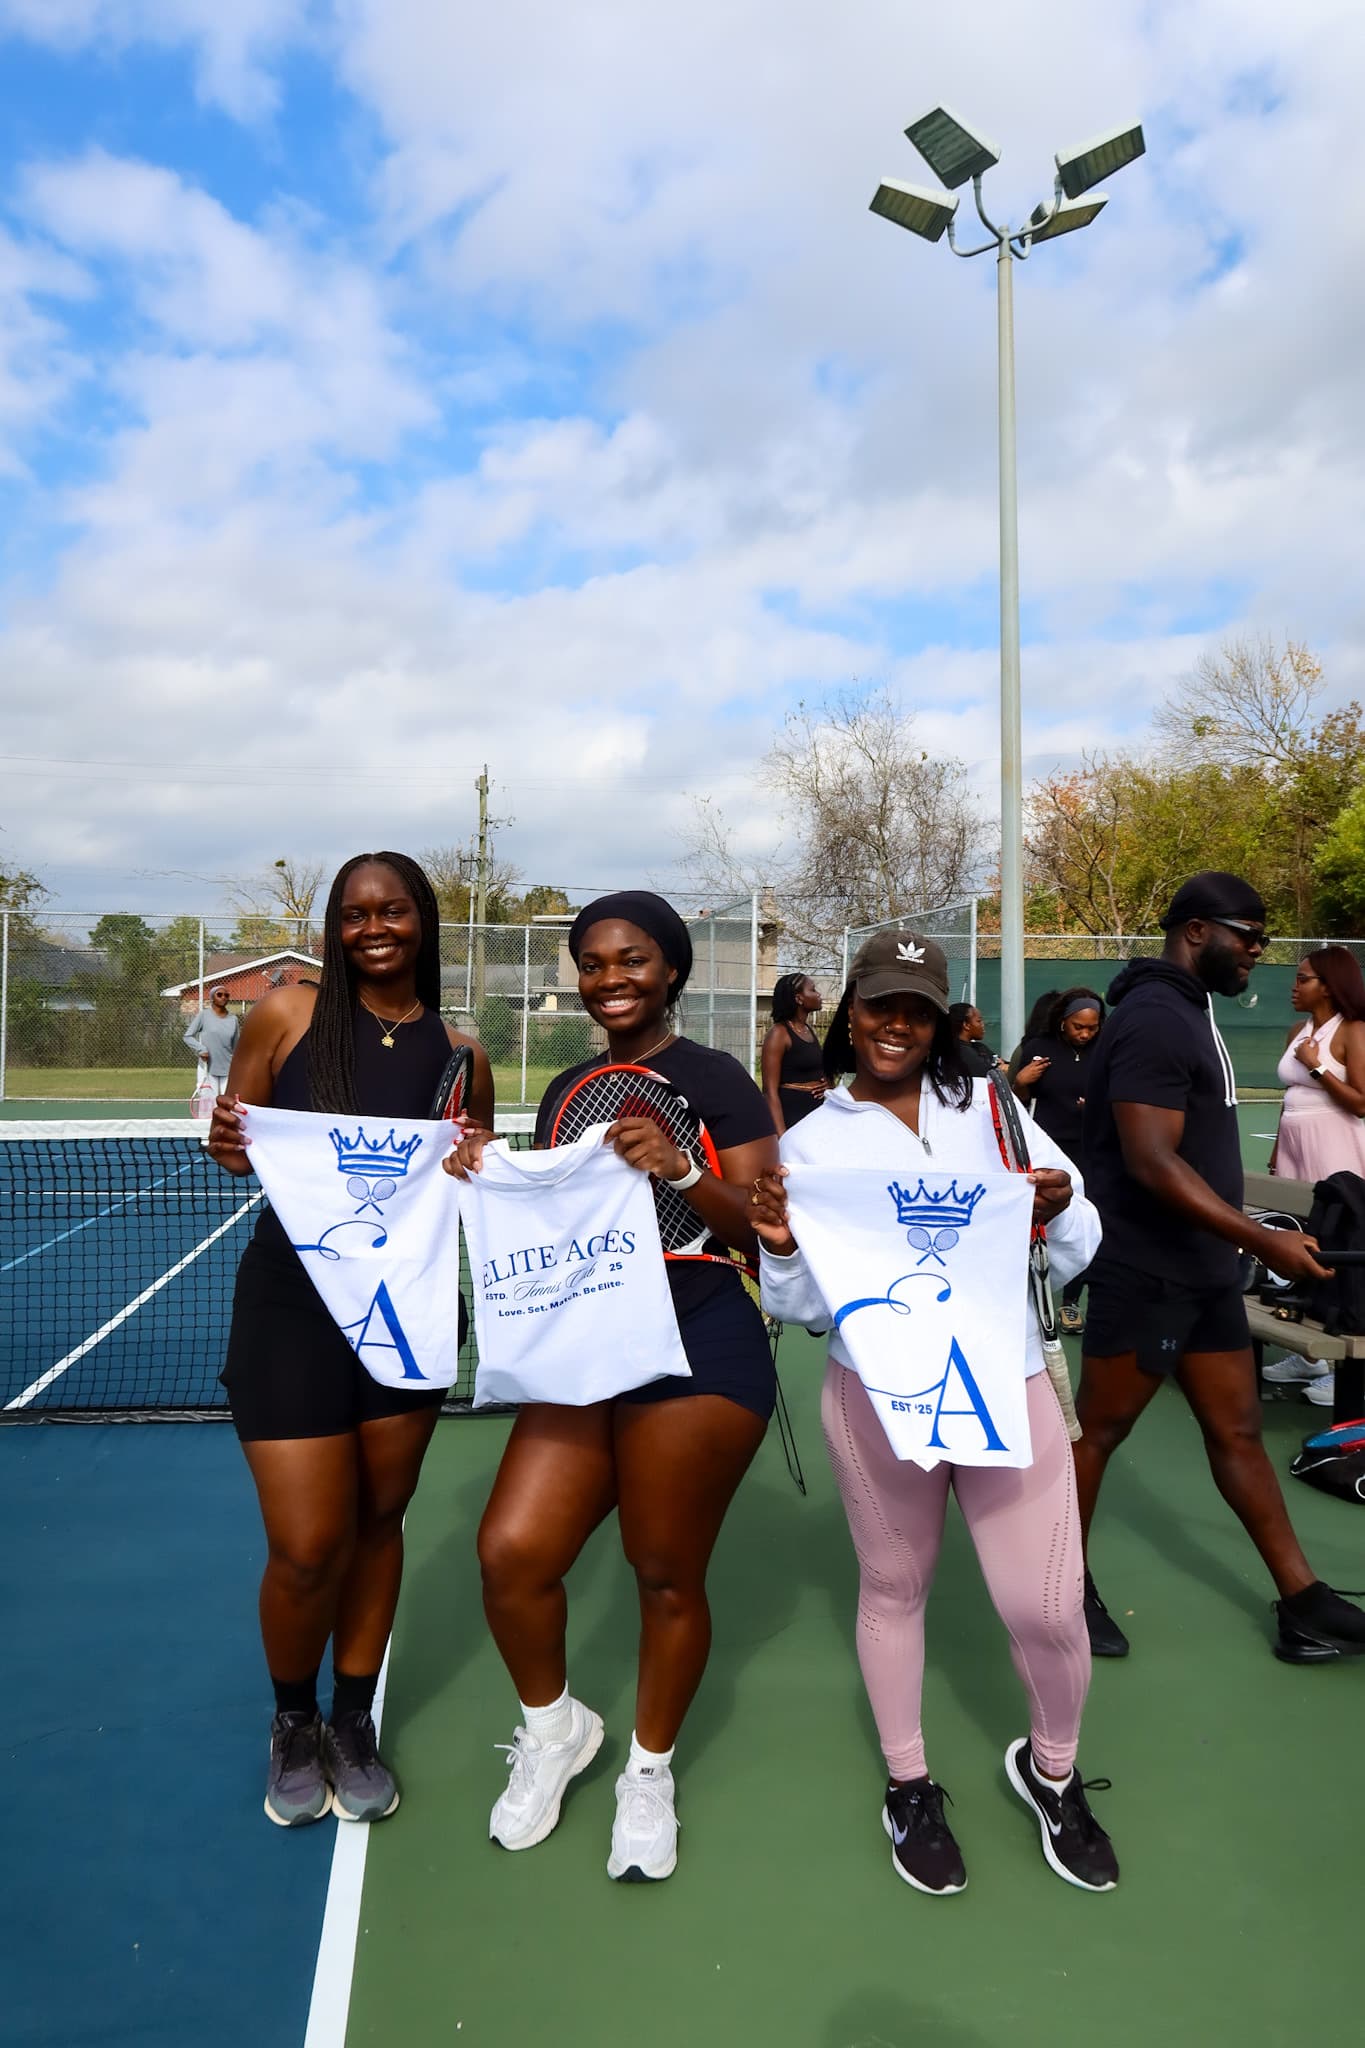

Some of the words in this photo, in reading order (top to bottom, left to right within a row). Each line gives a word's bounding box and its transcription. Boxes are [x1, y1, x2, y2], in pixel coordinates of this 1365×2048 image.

[482, 1245, 558, 1289] ELITE
[565, 1229, 636, 1262] ACES
[498, 1309, 525, 1317] Love.
[527, 1305, 548, 1314] Set.
[583, 1287, 596, 1295] Be
[597, 1280, 624, 1291] Elite.
[513, 1280, 562, 1301] Tennis
[609, 1262, 623, 1272] 25
[891, 1400, 911, 1413] EST
